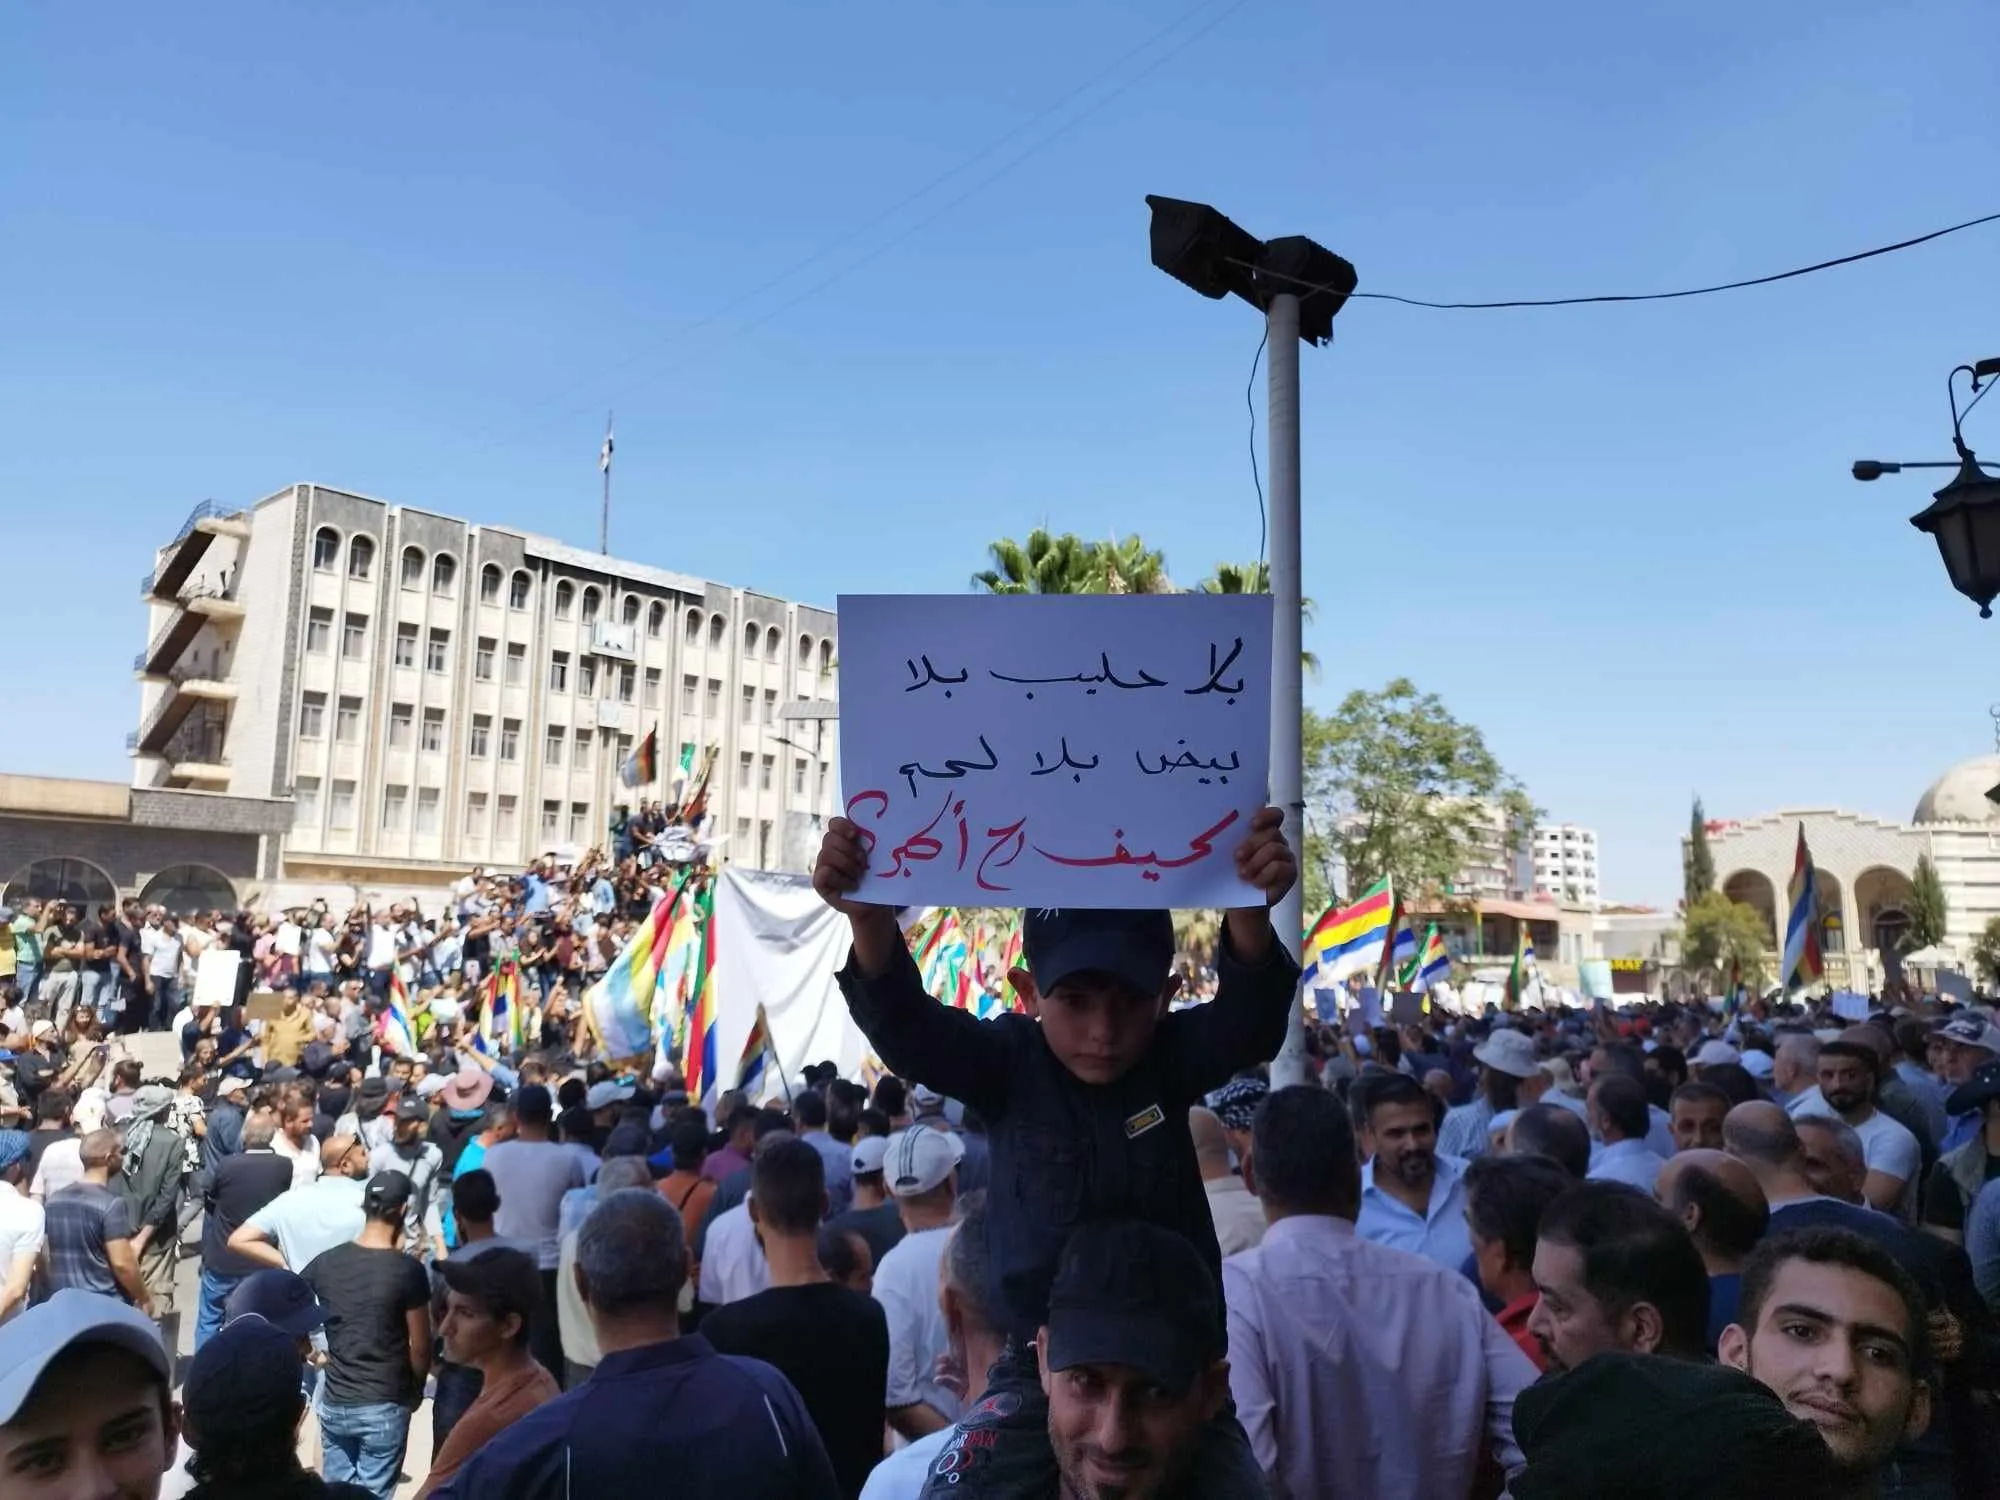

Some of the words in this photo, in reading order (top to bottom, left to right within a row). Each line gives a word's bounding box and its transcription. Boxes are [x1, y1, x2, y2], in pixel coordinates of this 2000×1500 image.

[905, 654, 968, 699] بلا
[989, 651, 1169, 700] حليب
[1184, 637, 1244, 705] بلا
[898, 735, 999, 799] لحم
[1030, 736, 1099, 783] بلا
[1135, 739, 1241, 785] بيض
[1032, 808, 1240, 882] كيف
